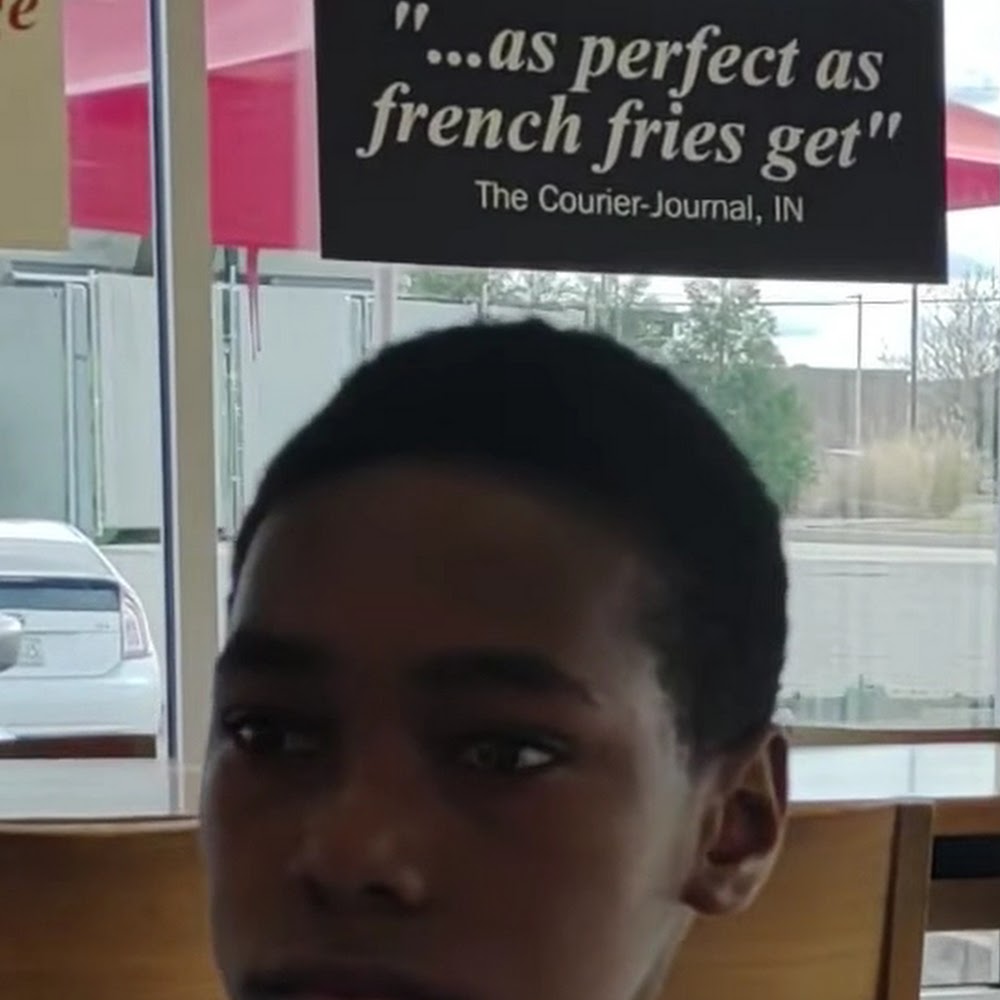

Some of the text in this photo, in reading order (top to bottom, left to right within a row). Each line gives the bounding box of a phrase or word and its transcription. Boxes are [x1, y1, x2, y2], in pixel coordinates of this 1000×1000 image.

[568, 24, 799, 98] perfect
[815, 49, 883, 91] as
[355, 81, 902, 181] french fries get"
[475, 180, 804, 224] The Courier-Journal, IN
